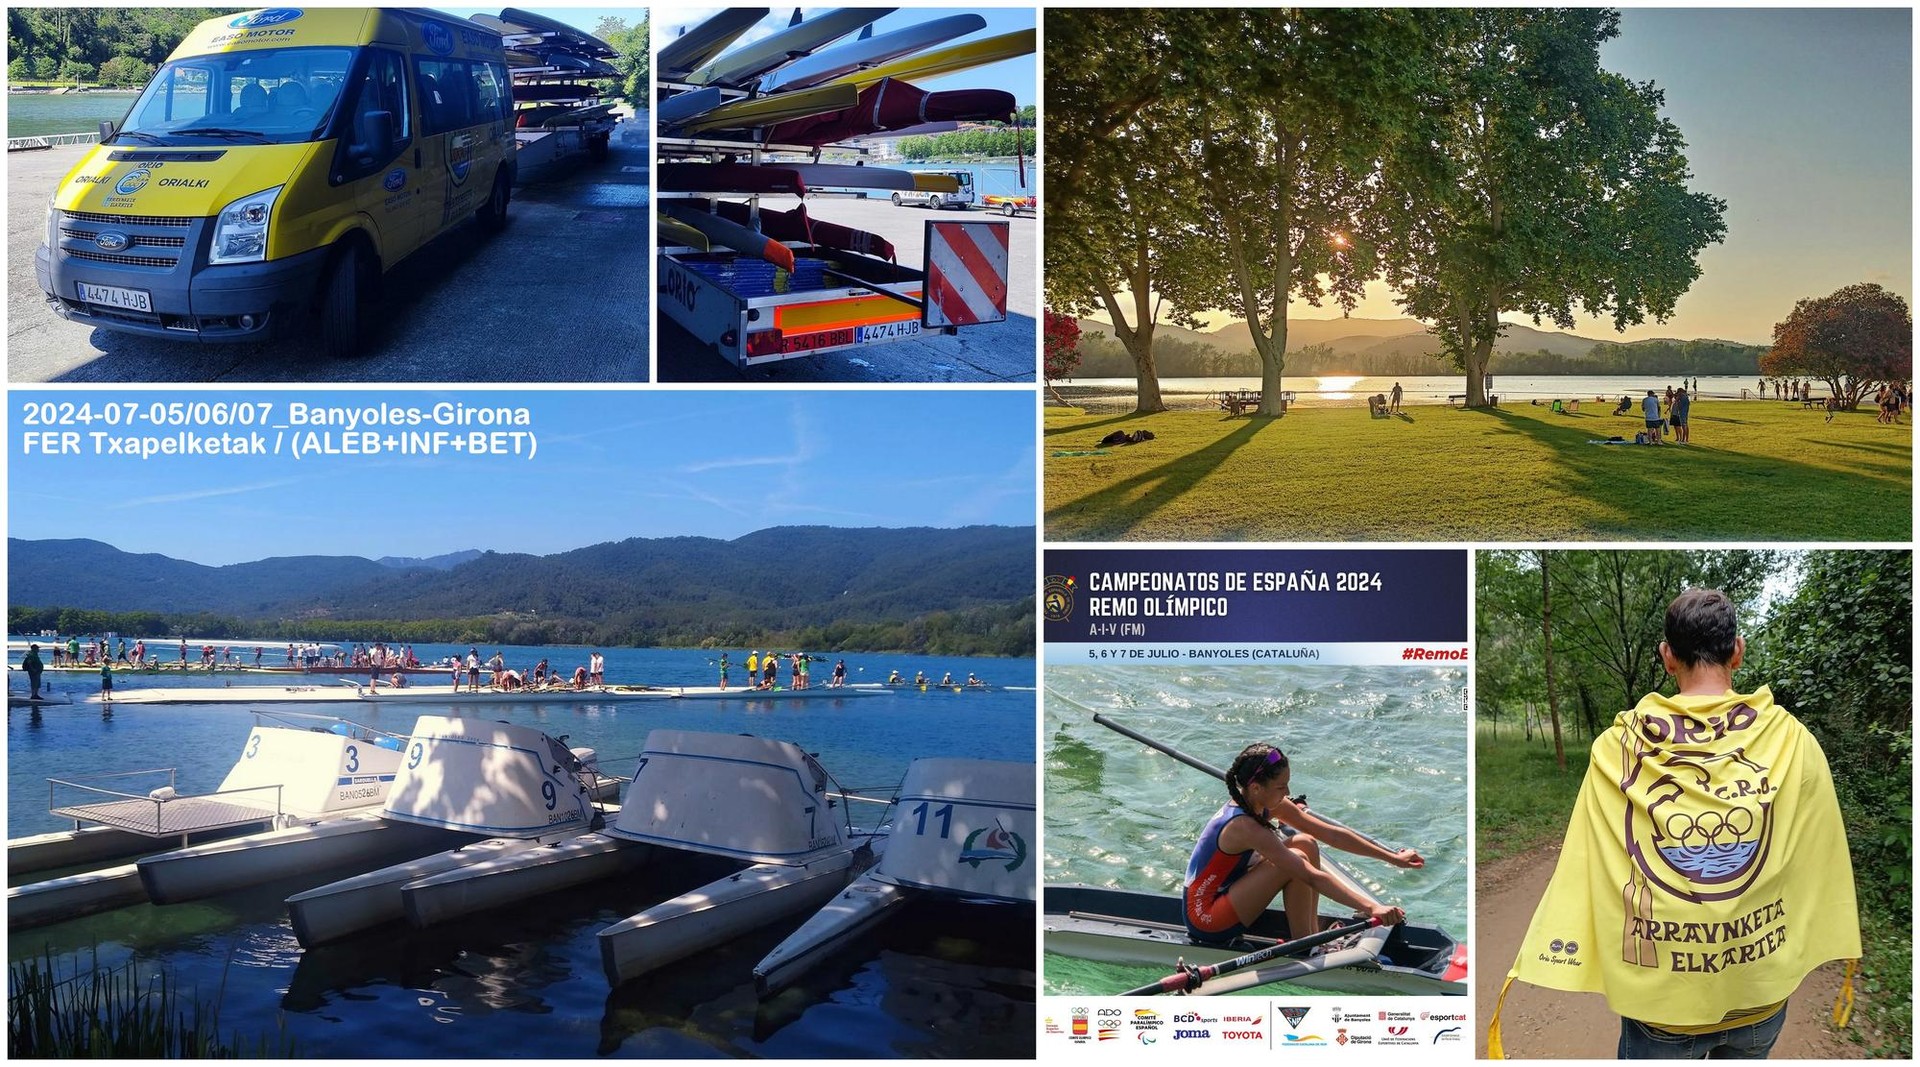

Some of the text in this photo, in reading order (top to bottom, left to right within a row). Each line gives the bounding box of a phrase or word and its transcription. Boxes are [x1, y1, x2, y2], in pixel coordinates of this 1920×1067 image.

[238, 11, 289, 26] Ford
[211, 29, 295, 43] EASO MOTOR
[75, 176, 112, 184] ORIALKI
[158, 178, 209, 188] ORIALKI
[100, 236, 117, 247] Ford
[87, 286, 118, 304] 4474
[864, 321, 919, 340] 4474 HJB
[793, 333, 826, 350] 5416
[1089, 569, 1383, 592] CAMPEONATOS DE ESPAÑA 2024
[1089, 597, 1138, 617] REMO
[1143, 594, 1228, 617] OLÍMPICO
[1089, 623, 1146, 638] A-I-V (FM)
[1089, 649, 1098, 660] 5,
[1101, 649, 1108, 659] 6
[1110, 649, 1118, 659] Y
[1120, 649, 1127, 659] 7
[1129, 649, 1144, 659] DE
[1147, 649, 1180, 659] JULIO
[1189, 649, 1249, 659] BANYOLES
[1252, 647, 1320, 661] (CATALUÑA)
[246, 735, 261, 759] 3
[345, 745, 359, 773] 3
[408, 742, 423, 770] 9
[632, 758, 648, 784] 7
[541, 780, 556, 810] 9
[804, 806, 816, 840] 7
[912, 802, 954, 840] 11
[1671, 925, 1787, 973] ELKARTEA
[1551, 955, 1567, 965] Sport
[1567, 957, 1582, 966] Wear
[1173, 1014, 1195, 1023] BCD
[1430, 1014, 1467, 1022] esportcat
[1222, 1031, 1263, 1039] TOYOTA
